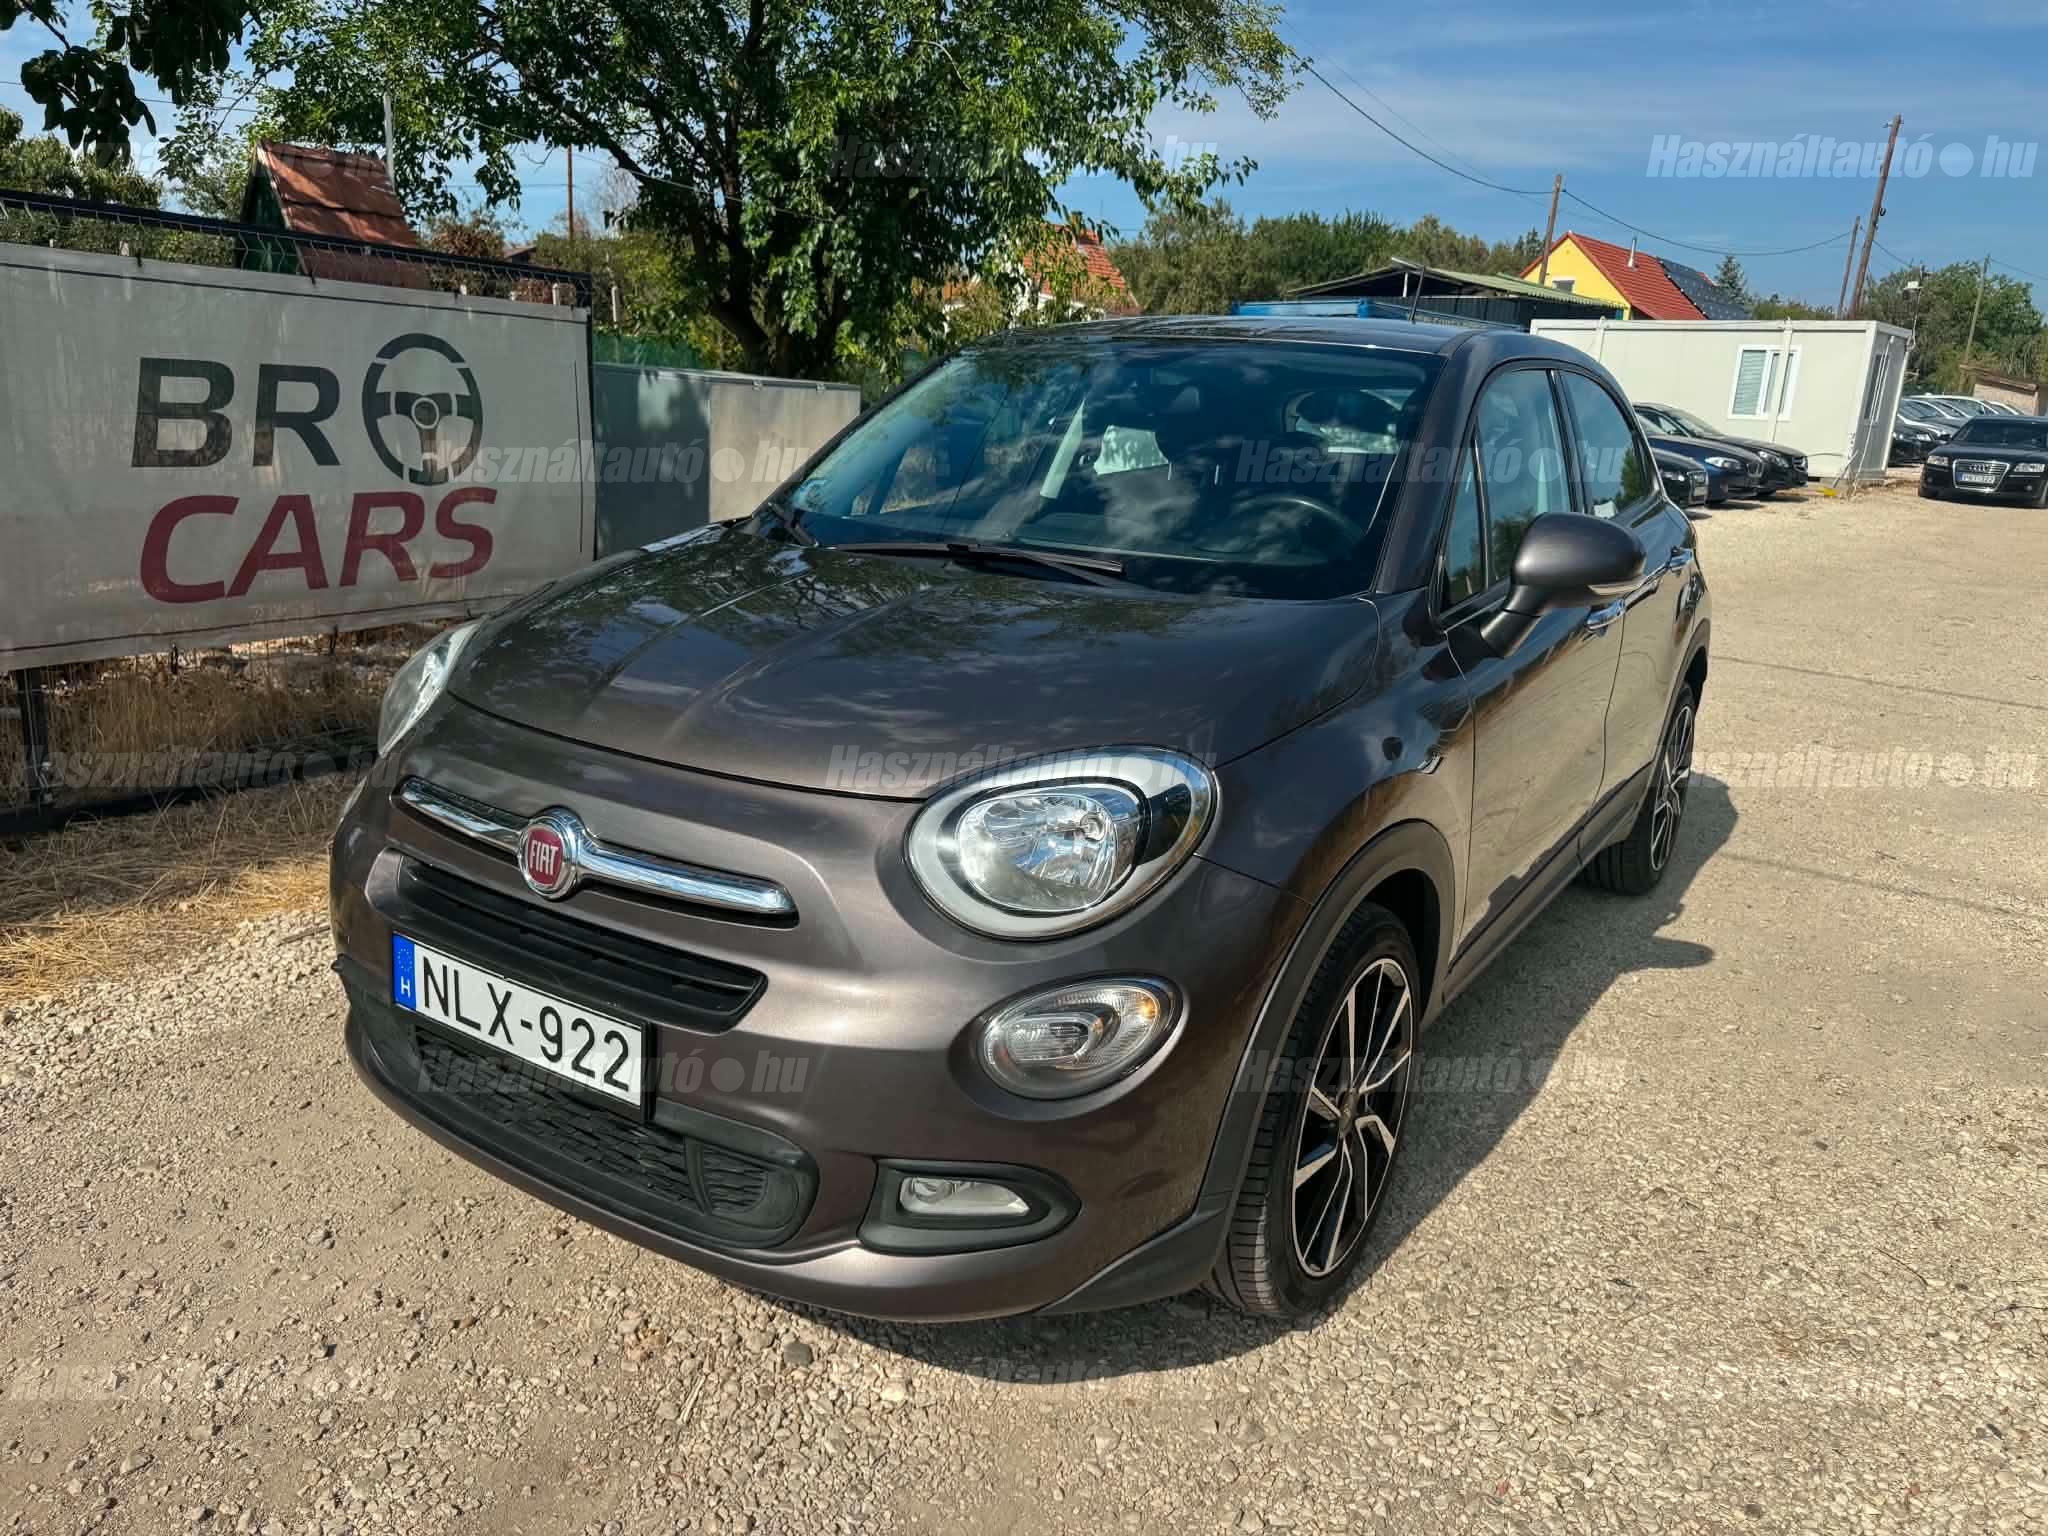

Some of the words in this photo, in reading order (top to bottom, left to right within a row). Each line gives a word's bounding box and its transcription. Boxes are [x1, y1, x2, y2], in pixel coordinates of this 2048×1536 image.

[140, 487, 498, 604] CARS
[530, 840, 558, 875] FIAT
[423, 957, 629, 1092] NLX-922
